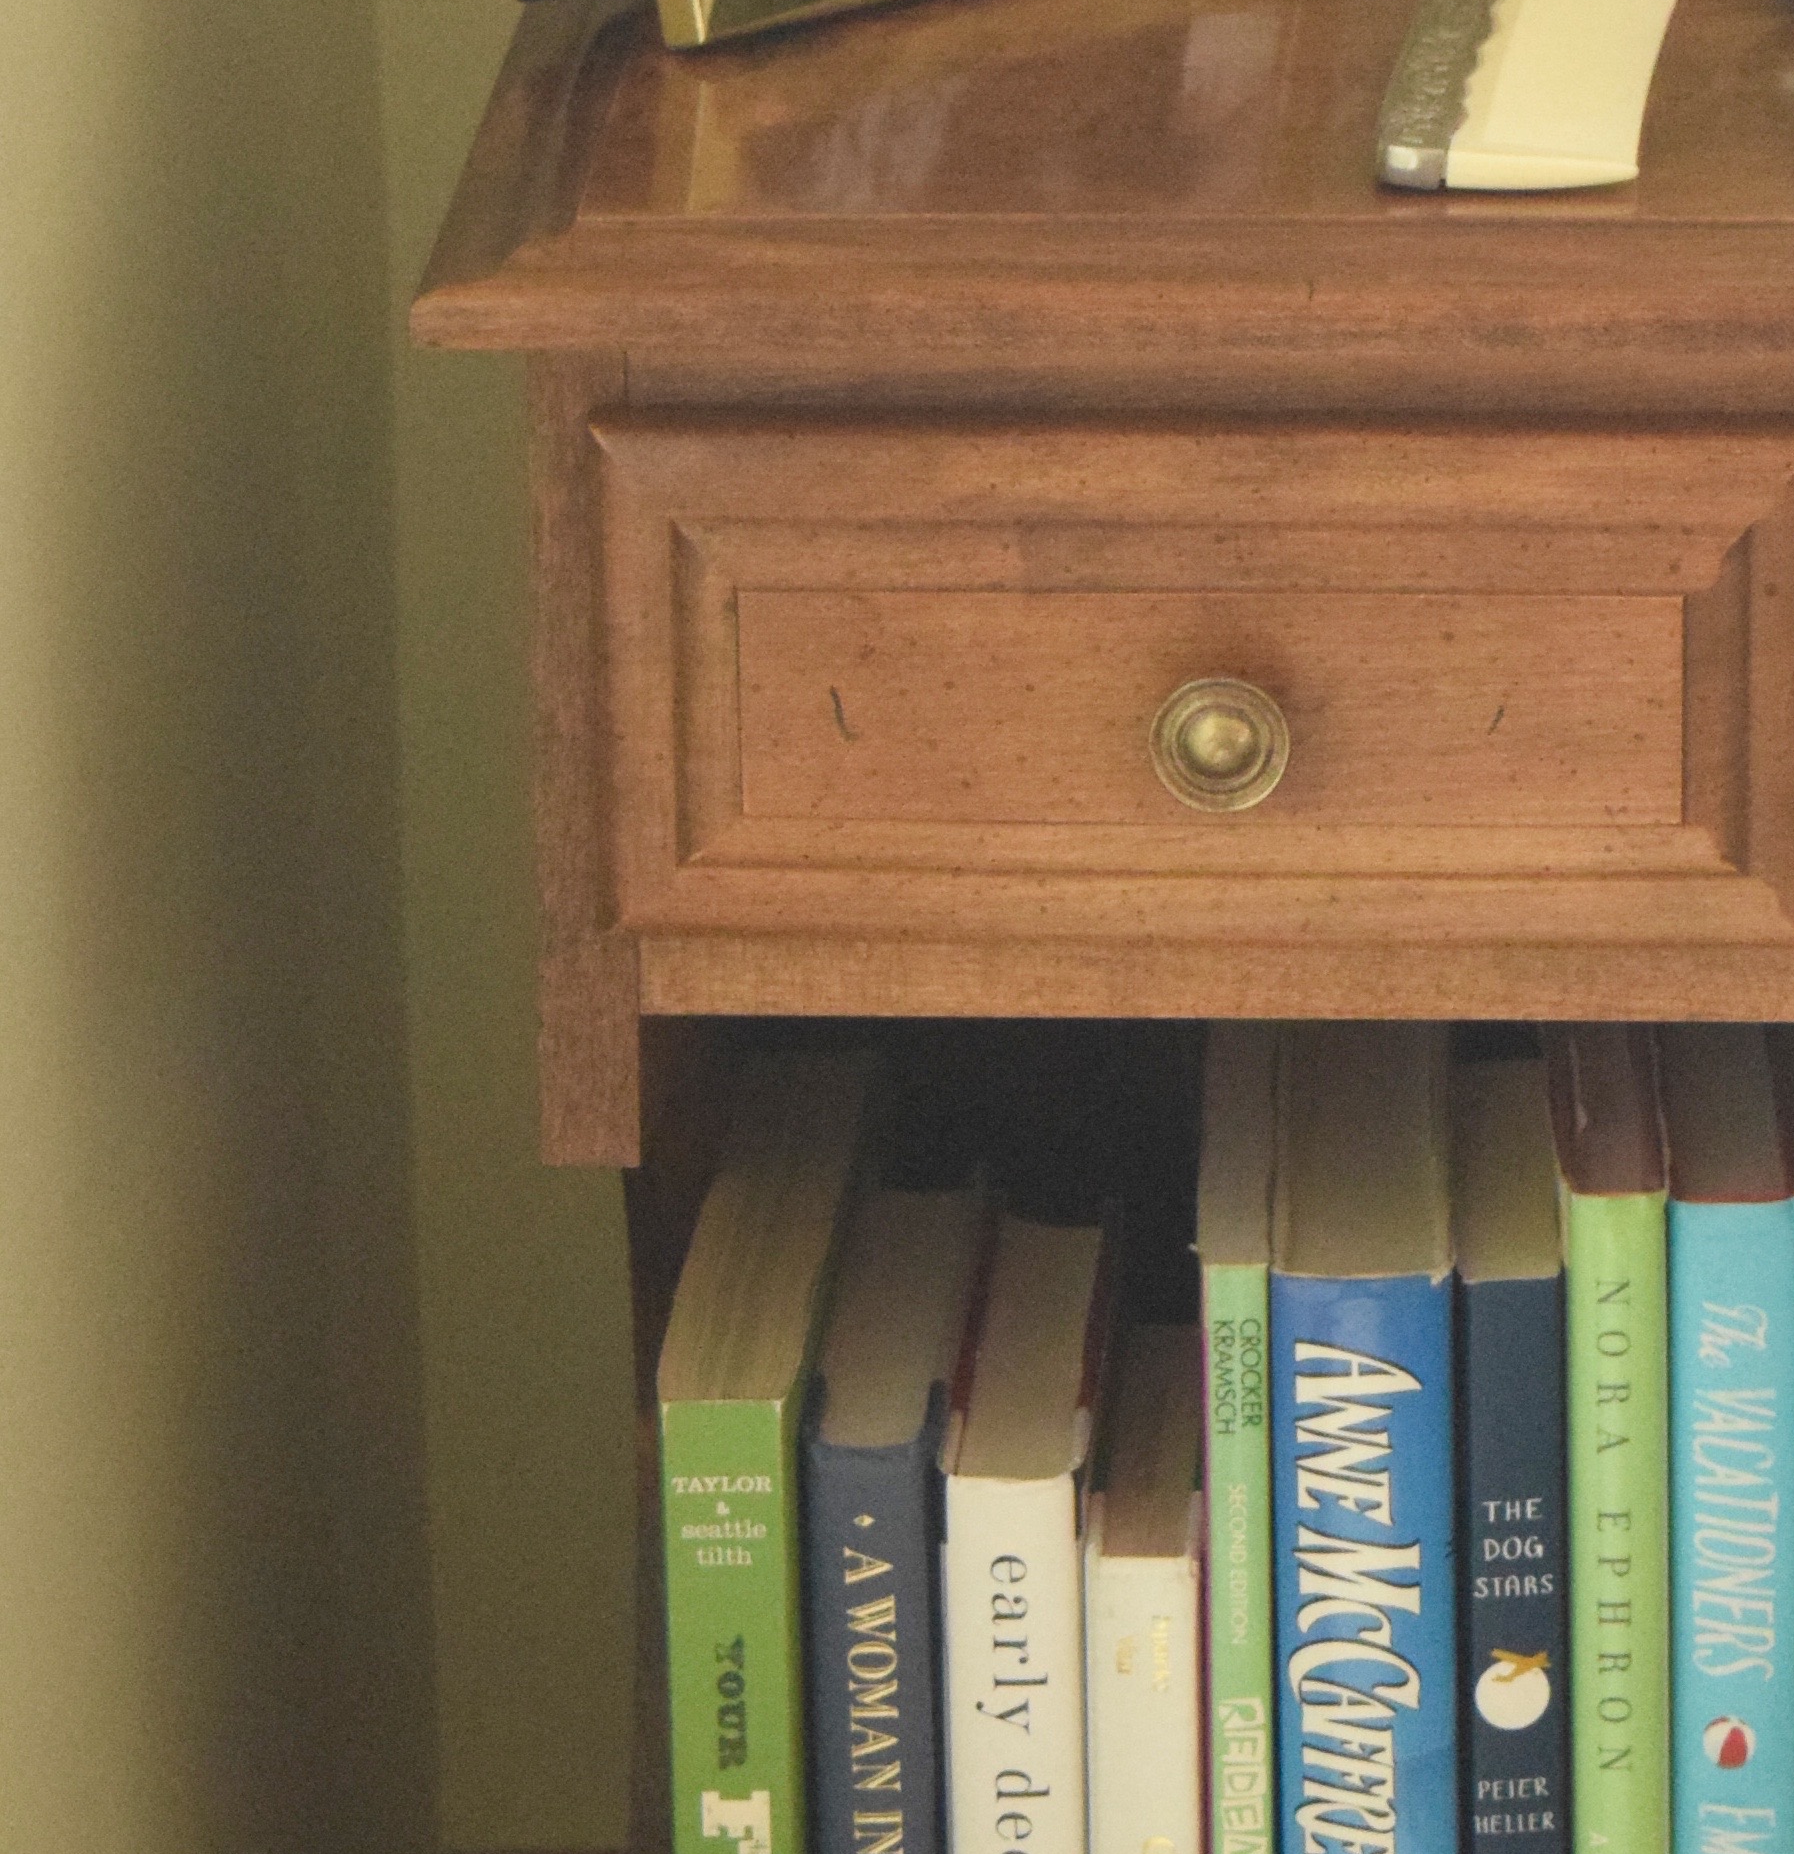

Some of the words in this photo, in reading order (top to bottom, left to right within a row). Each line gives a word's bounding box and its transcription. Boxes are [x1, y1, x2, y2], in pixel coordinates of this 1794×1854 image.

[1240, 1318, 1261, 1427] CROCKER
[1595, 1277, 1632, 1455] NORA
[1697, 1301, 1769, 1369] The
[1213, 1319, 1237, 1436] KRAMSCH
[1294, 1341, 1424, 1527] ANNE
[671, 1476, 772, 1493] TAYLOR
[716, 1501, 730, 1516] &
[1482, 1498, 1543, 1523] THE
[681, 1519, 767, 1538] seattle
[697, 1547, 753, 1565] tilth
[1228, 1483, 1247, 1564] SECOND
[1483, 1536, 1544, 1562] DOG
[1691, 1388, 1780, 1683] VACATIONERS
[842, 1547, 894, 1586] A
[1474, 1573, 1554, 1598] STARS
[975, 1554, 1049, 1735] early
[1229, 1568, 1249, 1645] EDITION
[1596, 1510, 1634, 1773] EPHRON
[714, 1635, 749, 1772] YOUR
[845, 1594, 903, 1792] WOMAN
[1473, 1811, 1555, 1833] HELLER
